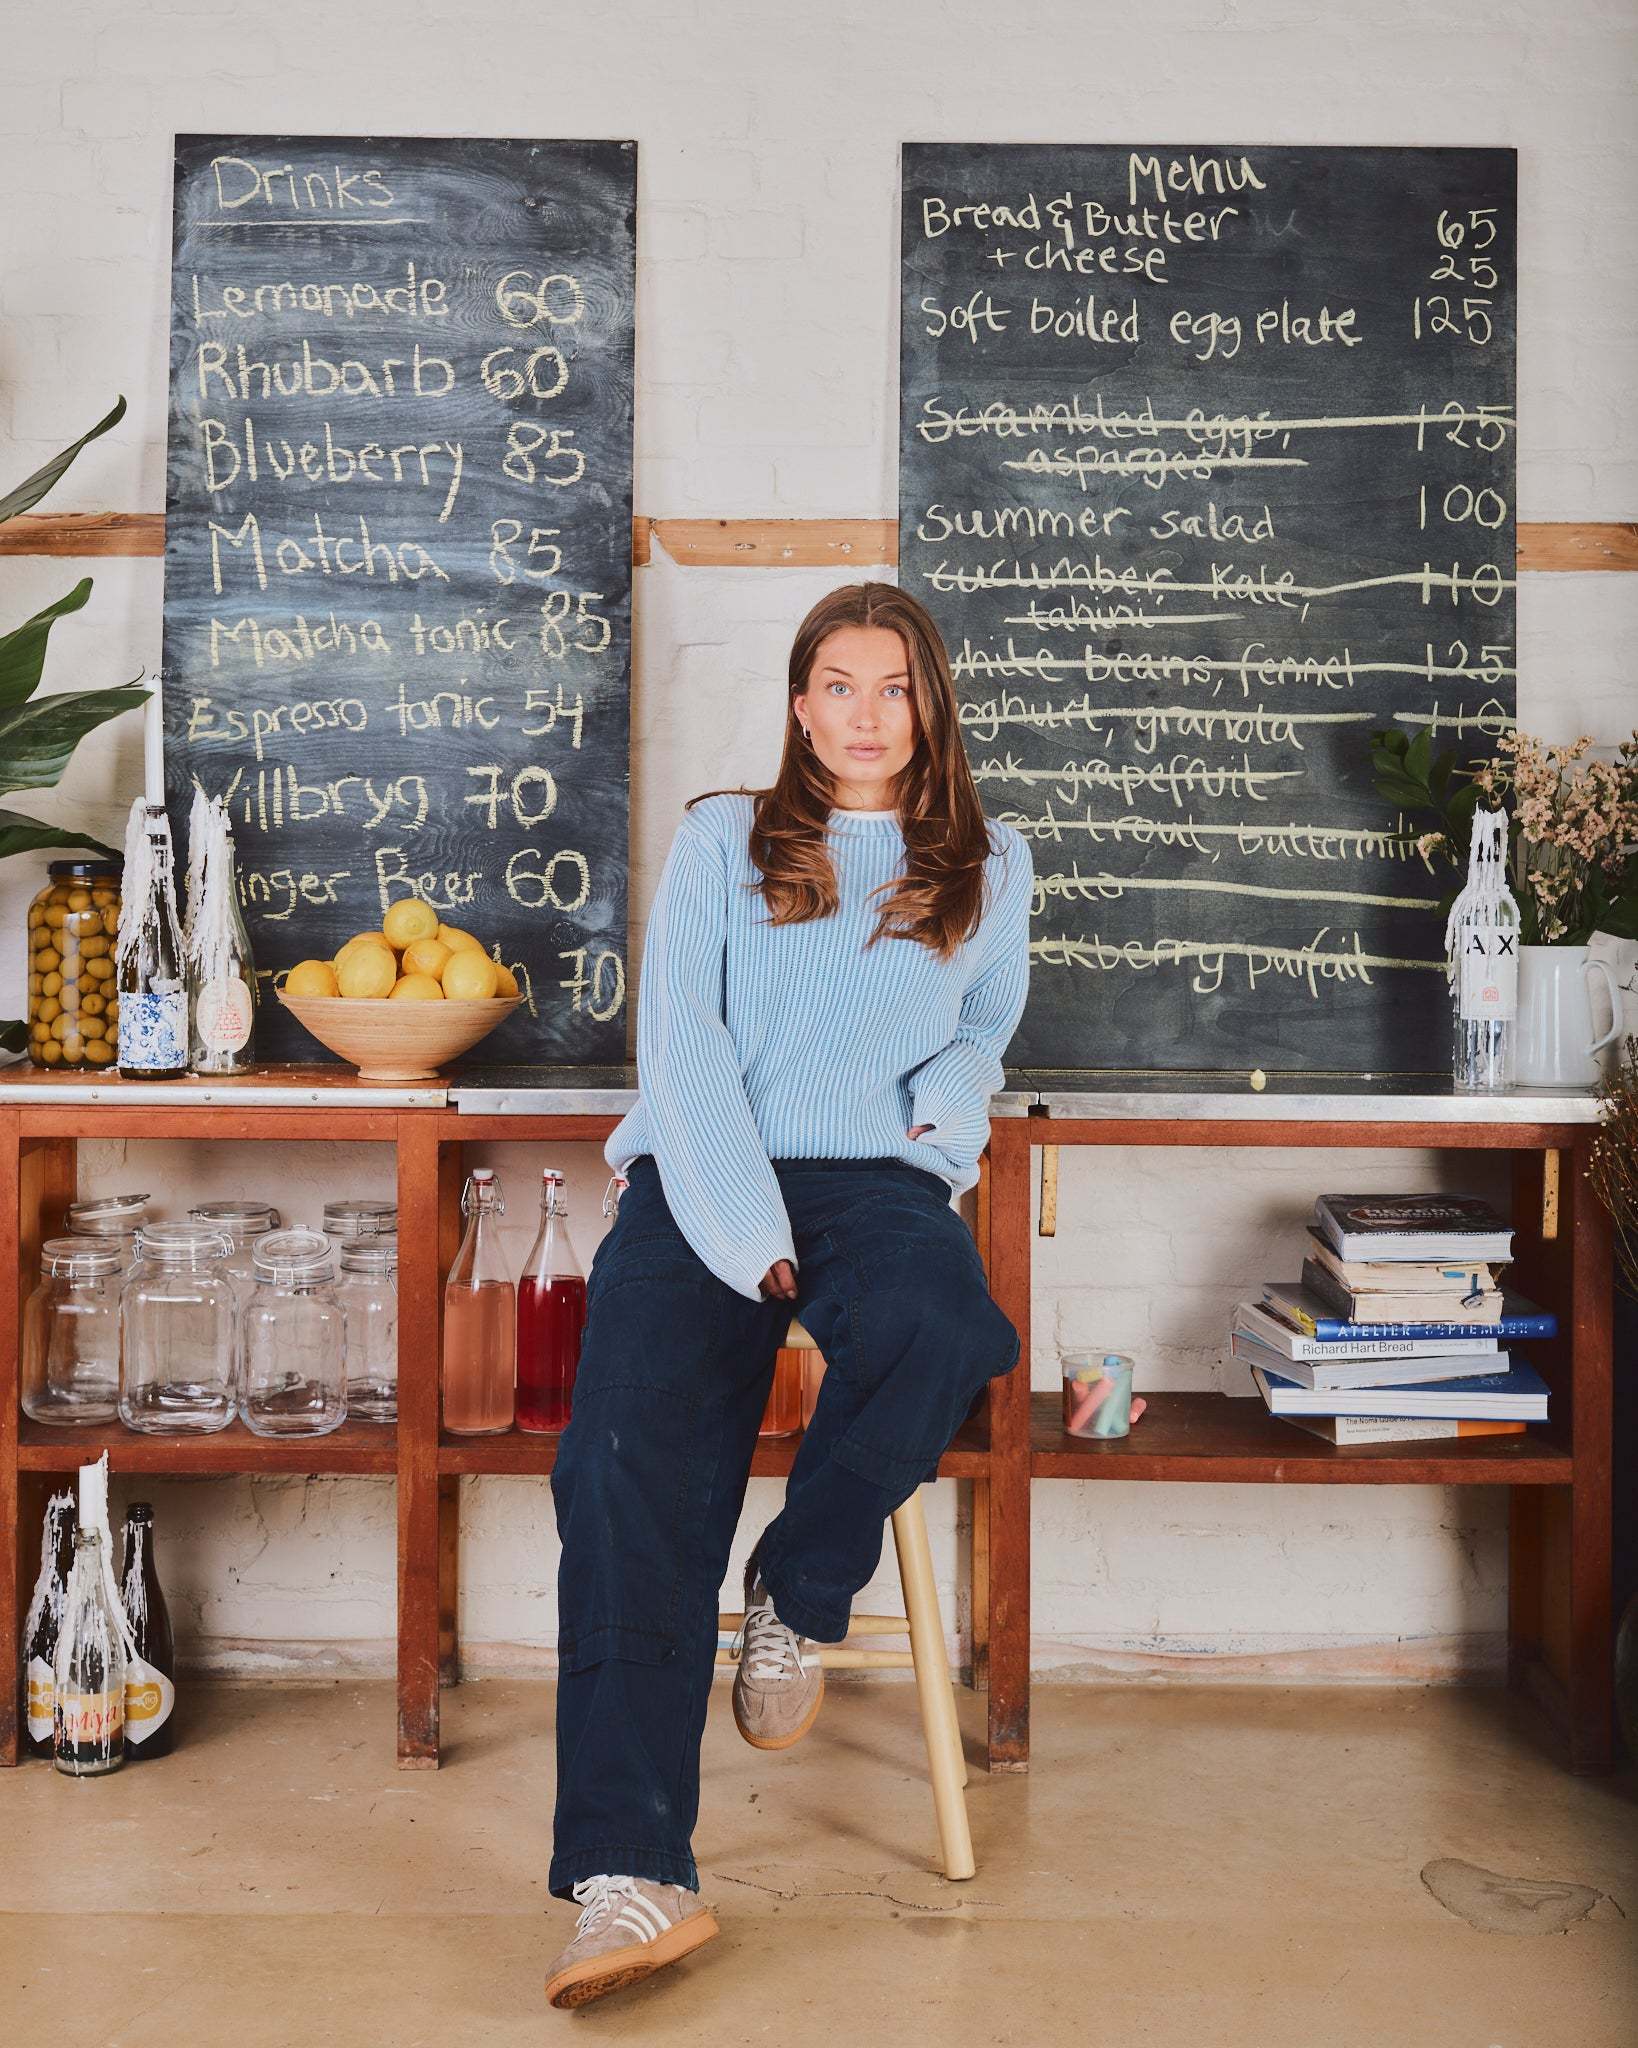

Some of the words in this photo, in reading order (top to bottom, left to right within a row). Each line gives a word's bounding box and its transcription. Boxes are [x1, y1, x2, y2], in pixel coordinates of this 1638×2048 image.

[210, 156, 394, 209] Drinks
[1129, 153, 1267, 205] Menu
[923, 193, 1041, 238] Bread
[1081, 201, 1239, 243] Butter
[1437, 209, 1499, 249] 65
[1025, 240, 1168, 283] cheese
[1430, 254, 1498, 289] 25
[192, 262, 449, 329] Lemonade
[495, 271, 585, 328] 60
[921, 290, 1012, 344] Soft
[1030, 294, 1139, 343] boiled
[1169, 310, 1242, 360] egg
[1256, 297, 1362, 347] plate
[1414, 296, 1493, 345] 125
[197, 340, 456, 400] Rhubarb
[480, 346, 570, 400] 60
[918, 393, 1159, 443] Scrambled
[1418, 400, 1514, 451] 125
[199, 418, 464, 522] Blueberry
[503, 422, 586, 486] 85
[917, 504, 1132, 541] Summer
[1150, 502, 1275, 543] salad
[1420, 484, 1508, 530] 100
[208, 512, 451, 594] Matcha
[489, 519, 562, 585] 85
[1421, 562, 1503, 607] 110
[209, 612, 393, 668] Matcha
[408, 608, 516, 656] tonic
[540, 591, 612, 660] 85
[952, 638, 1063, 683] hite
[1240, 643, 1355, 697] fennel
[1427, 639, 1512, 684] 125
[188, 697, 368, 761] Espresso
[385, 678, 502, 736] tonic
[521, 683, 585, 749] 54
[956, 689, 1115, 748] oghurt,
[1430, 698, 1508, 740] 110
[464, 765, 558, 830] 70
[186, 862, 351, 920] inger
[374, 847, 484, 916] Beer
[503, 848, 591, 912] 60
[558, 947, 626, 1022] 70
[1302, 1343, 1348, 1355] Richard
[1351, 1342, 1376, 1353] Hart
[1379, 1341, 1414, 1353] Bread
[1337, 1324, 1411, 1337] ATELIER
